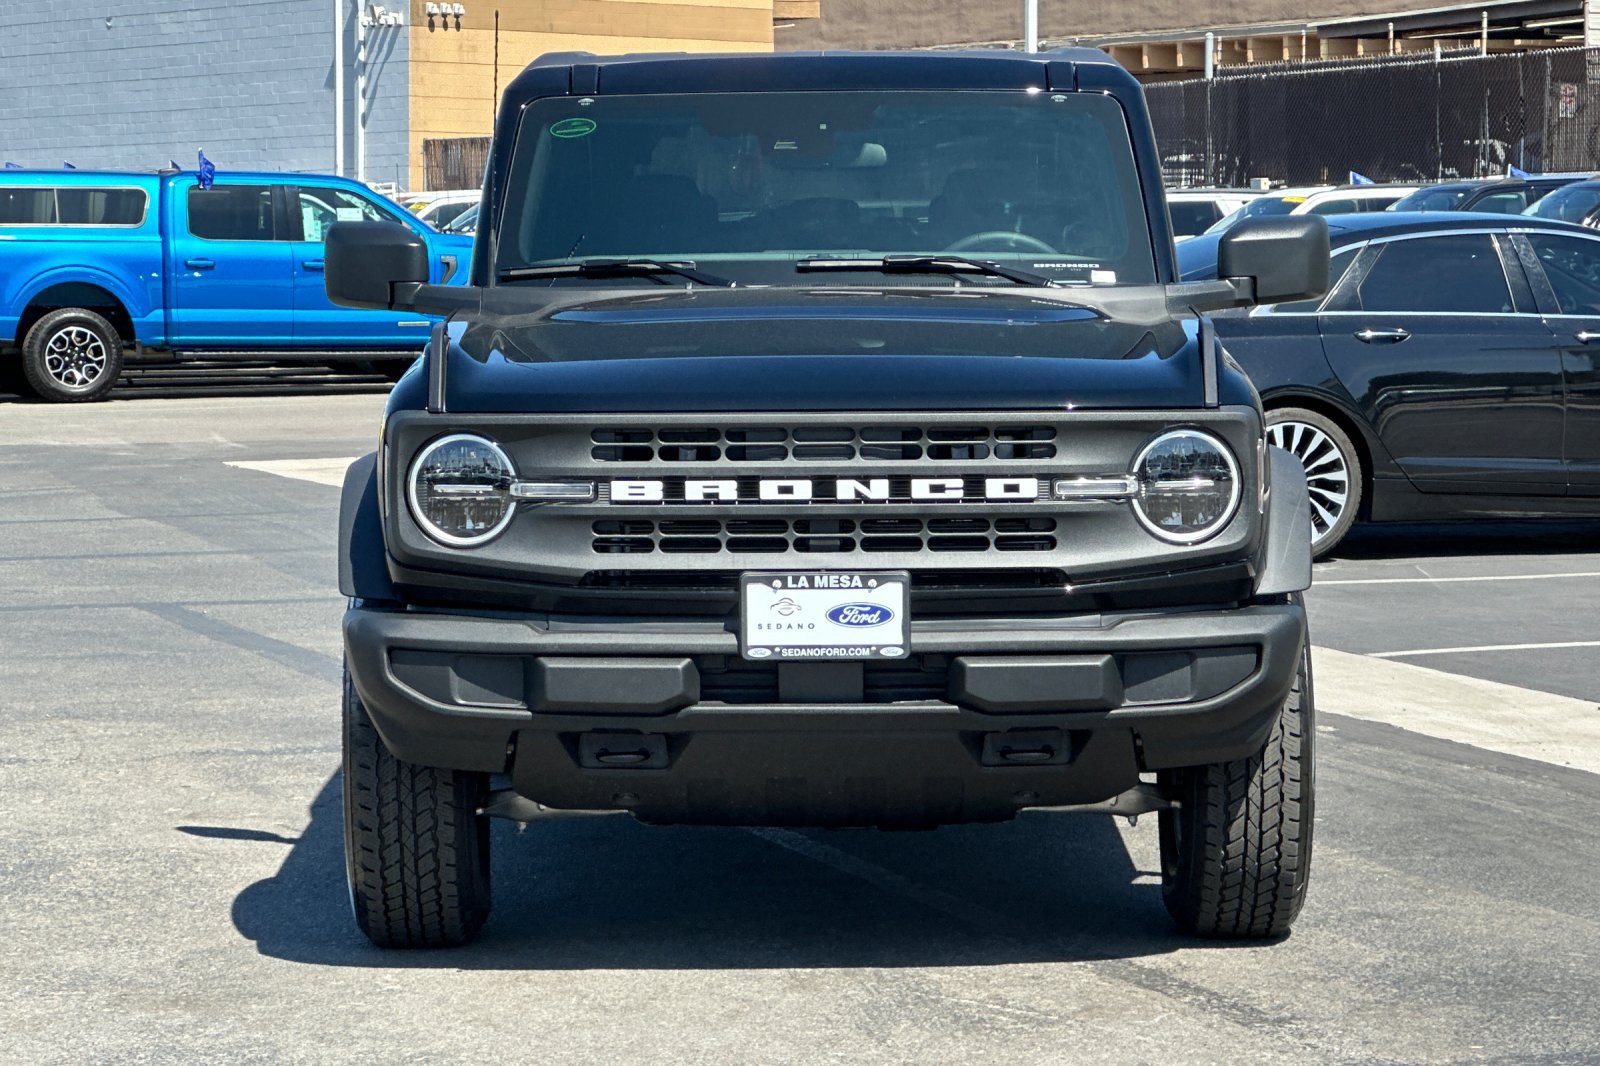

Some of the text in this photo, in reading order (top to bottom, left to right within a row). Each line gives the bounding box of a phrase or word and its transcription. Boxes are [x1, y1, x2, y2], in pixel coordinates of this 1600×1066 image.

[610, 478, 1039, 500] BRONCO
[787, 575, 863, 588] LA MESA
[838, 605, 881, 624] Ford
[781, 647, 870, 657] SEDANOFORD.COM
